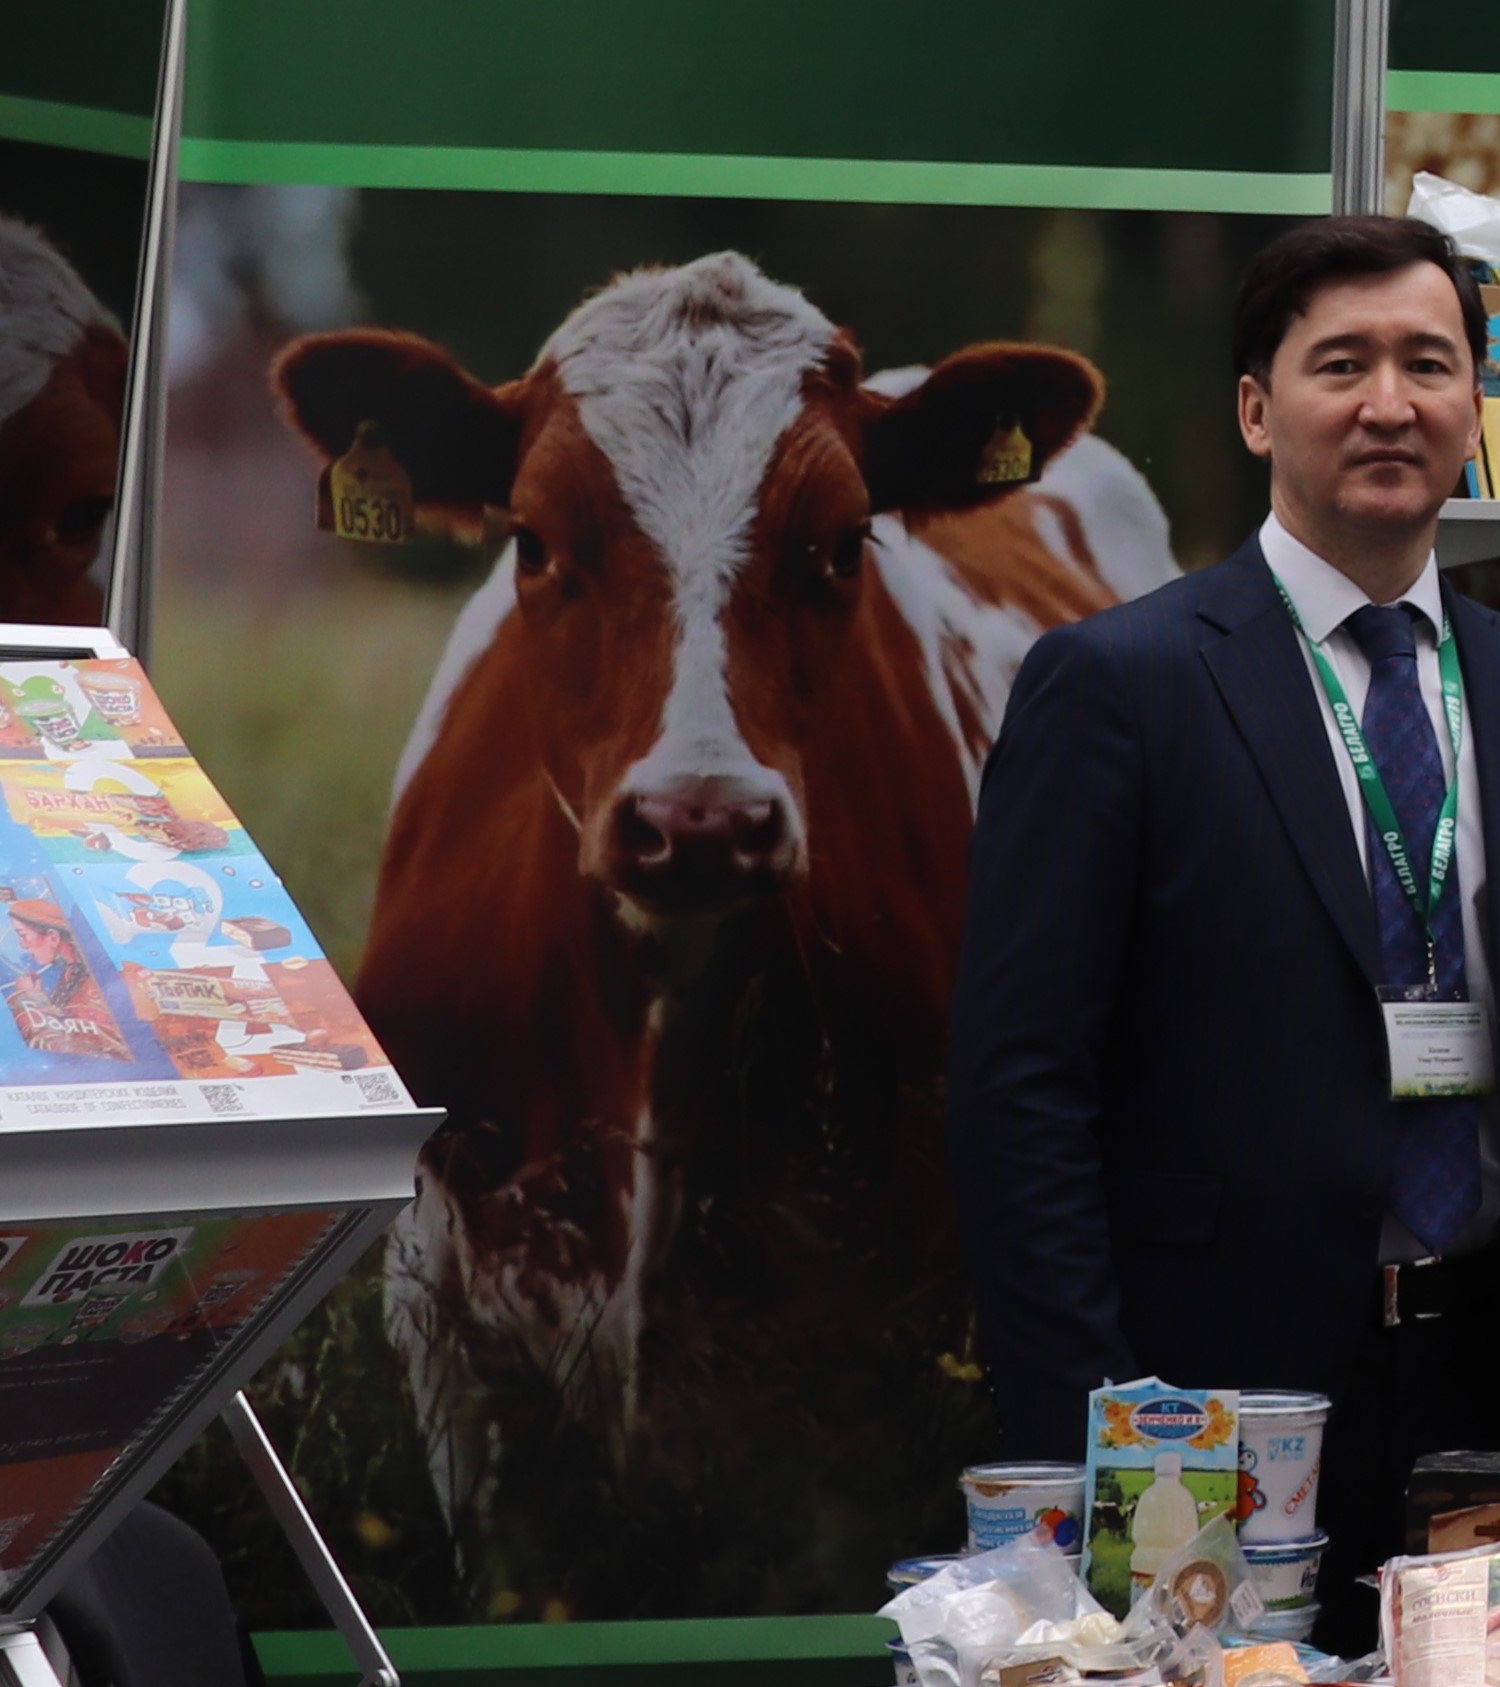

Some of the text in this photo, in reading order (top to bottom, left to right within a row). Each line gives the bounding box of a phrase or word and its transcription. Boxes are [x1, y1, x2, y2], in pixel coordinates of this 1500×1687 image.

[341, 496, 401, 541] 0530
[1333, 702, 1370, 763] БЕЛАГРО
[25, 790, 111, 810] БАРХАН
[1383, 831, 1417, 895] БЕЛАГРО
[1432, 817, 1455, 881] БЕЛАГРО
[21, 1000, 99, 1035] Баян
[56, 1237, 178, 1272] ШОКО
[1282, 1438, 1305, 1452] KZ
